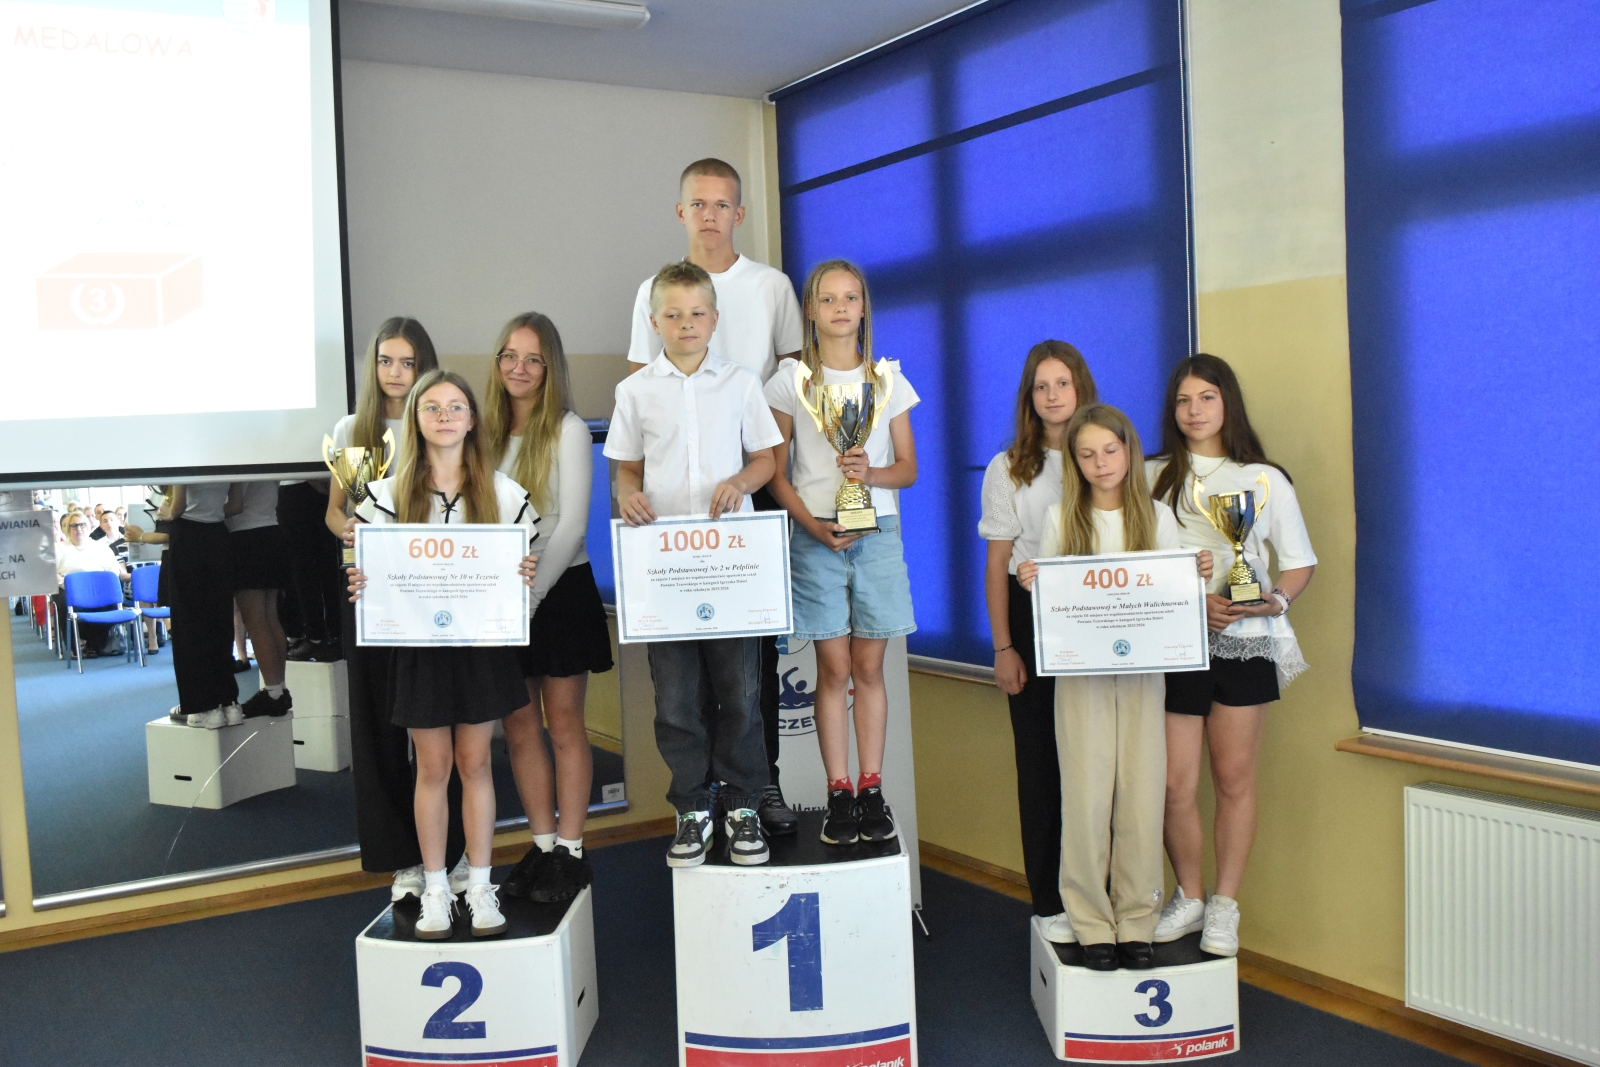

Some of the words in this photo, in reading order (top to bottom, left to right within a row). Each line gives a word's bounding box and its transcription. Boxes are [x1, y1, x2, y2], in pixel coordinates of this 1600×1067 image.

[13, 26, 193, 58] MEDALOWA
[88, 288, 108, 312] 3
[409, 538, 454, 559] 600
[462, 546, 479, 558] ZŁ
[659, 529, 720, 552] 1000
[728, 535, 746, 549] ZŁ
[9, 554, 25, 563] NA
[669, 566, 708, 574] Podstawowej
[732, 563, 759, 571] Pełplinie
[1083, 568, 1128, 589] 400
[1136, 573, 1154, 587] ZŁ
[1072, 604, 1111, 612] Podstawowej
[1119, 602, 1142, 611] Małych
[1144, 600, 1189, 608] Walichnowach
[752, 892, 824, 1012] 1
[420, 961, 486, 1040] 2
[1134, 979, 1173, 1028] 3
[1186, 1036, 1229, 1056] polanik
